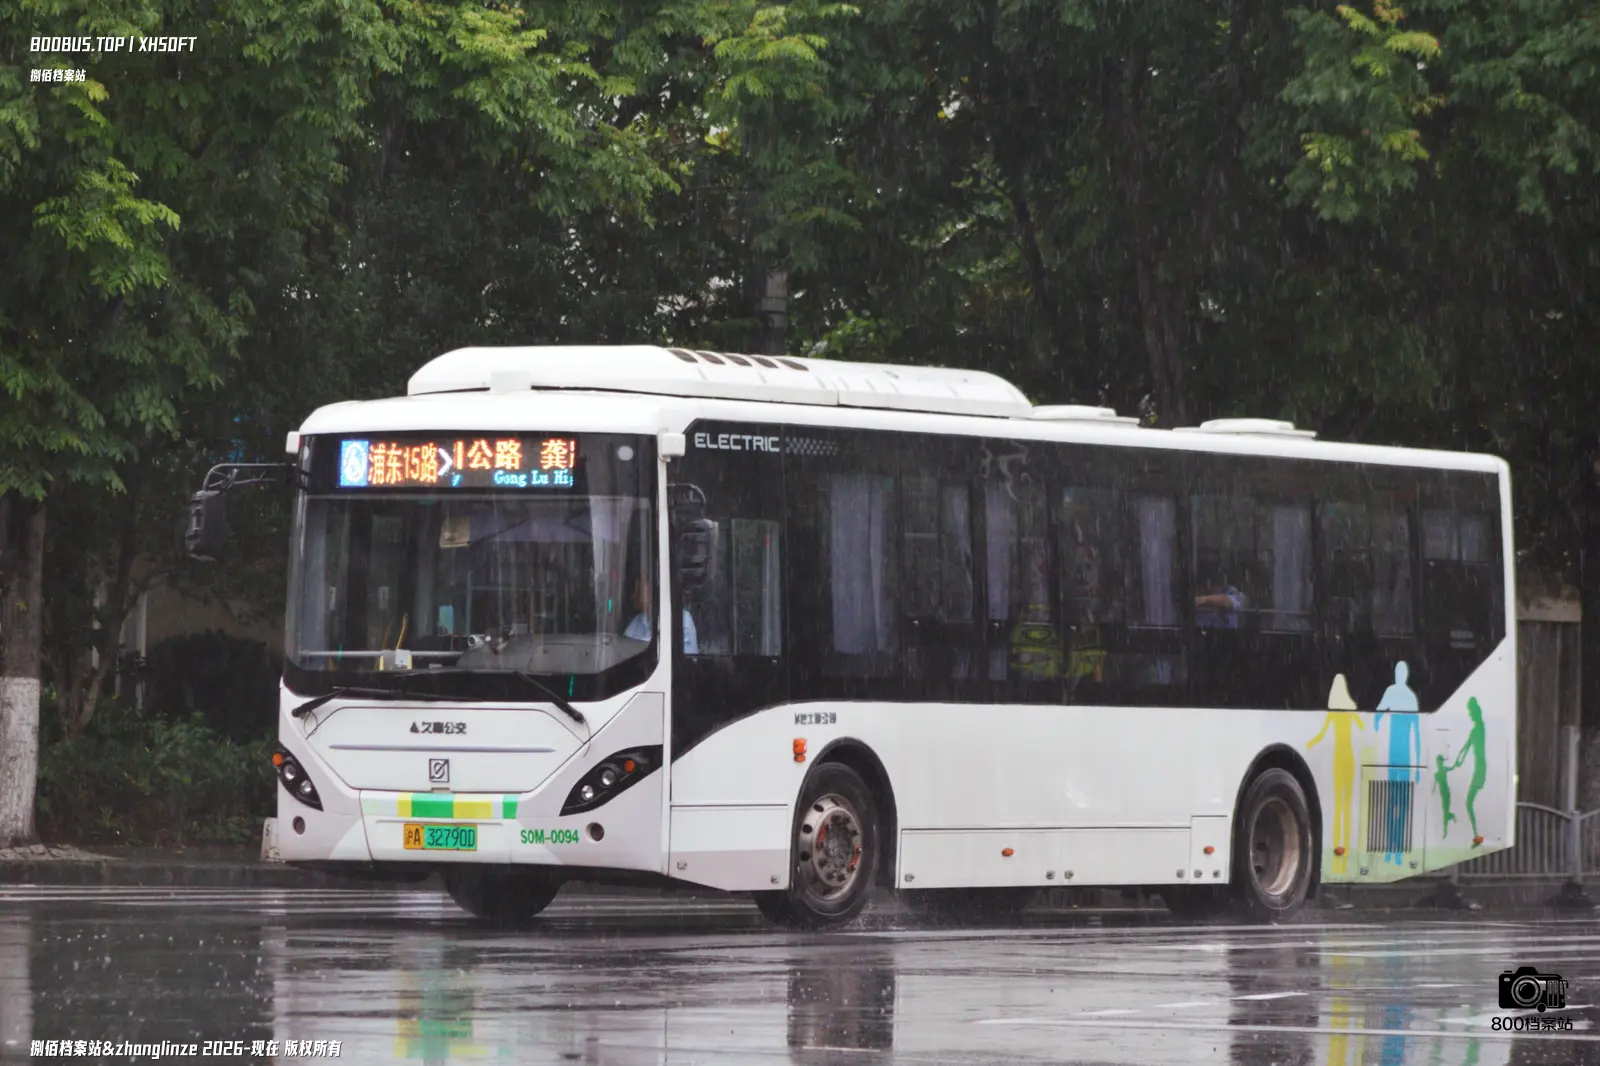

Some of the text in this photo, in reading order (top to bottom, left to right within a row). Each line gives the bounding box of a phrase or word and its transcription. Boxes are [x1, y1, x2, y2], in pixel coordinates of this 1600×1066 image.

[540, 438, 575, 469] 龚
[694, 432, 780, 452] ELECTRIC
[368, 442, 438, 484] 浦东15路
[494, 470, 527, 487] Gong
[531, 470, 549, 485] Lu
